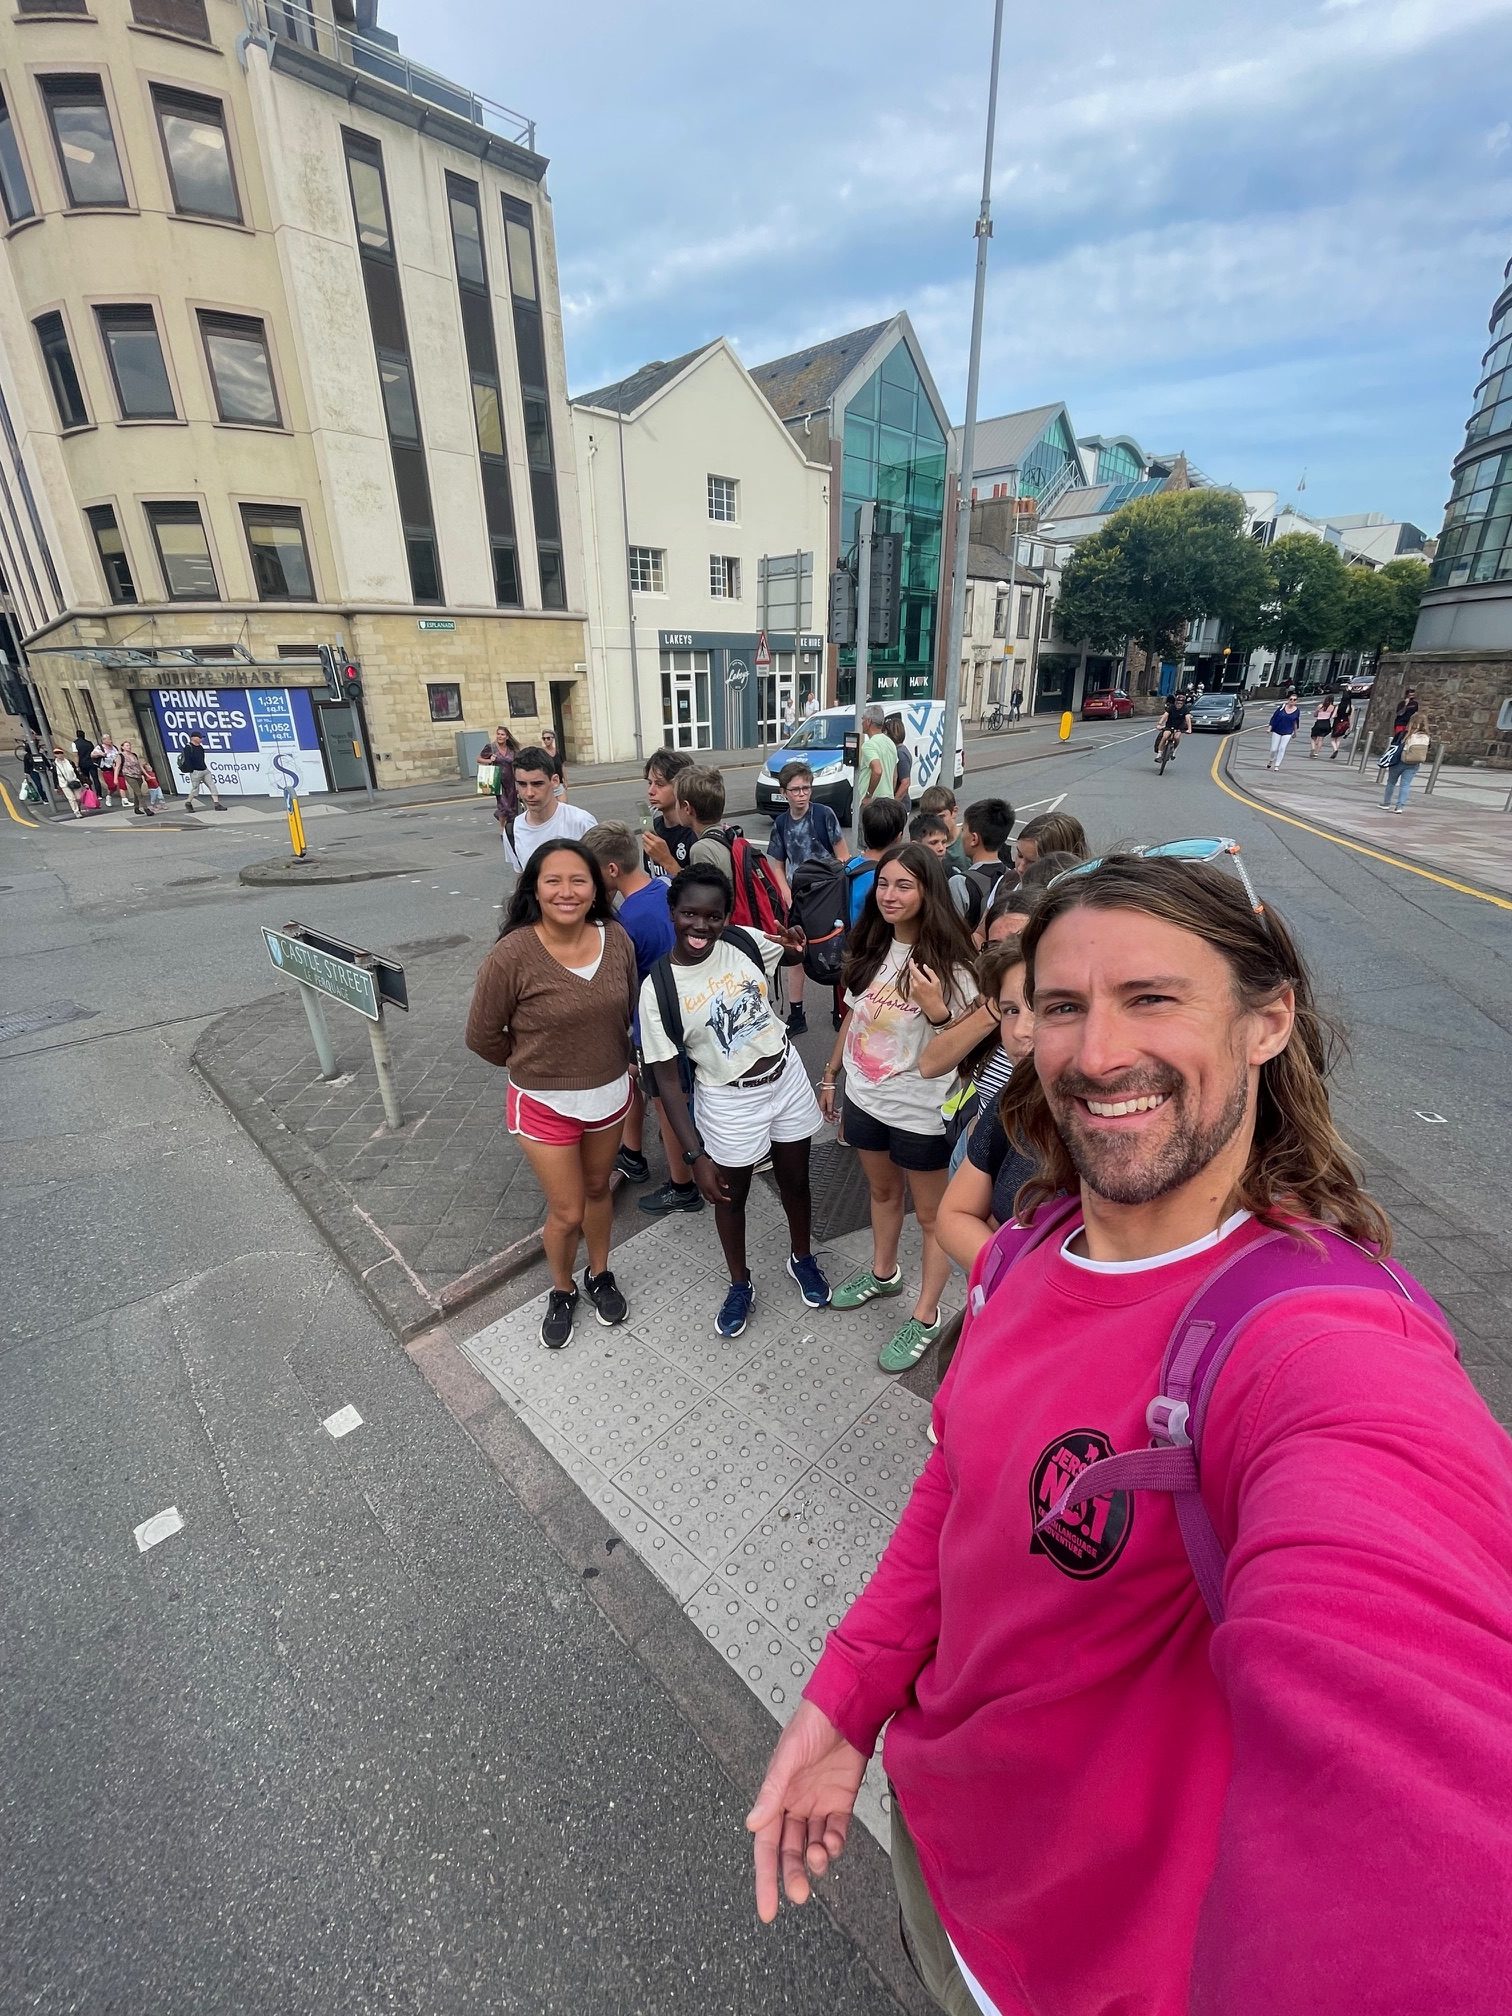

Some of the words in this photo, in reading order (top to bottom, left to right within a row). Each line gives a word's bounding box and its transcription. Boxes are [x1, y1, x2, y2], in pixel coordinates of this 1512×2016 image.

[664, 634, 693, 645] LAKEYS
[157, 672, 213, 685] JUBILEE
[221, 671, 282, 685] WHARF
[158, 690, 220, 708] PRIME
[257, 696, 285, 706] 1,321
[164, 710, 247, 729] OFFICES
[258, 723, 290, 734] 11,052
[210, 761, 260, 773] Company
[280, 939, 323, 973] CASTLE
[324, 959, 369, 996] STREET
[1058, 1524, 1098, 1559] LANGUAGE
